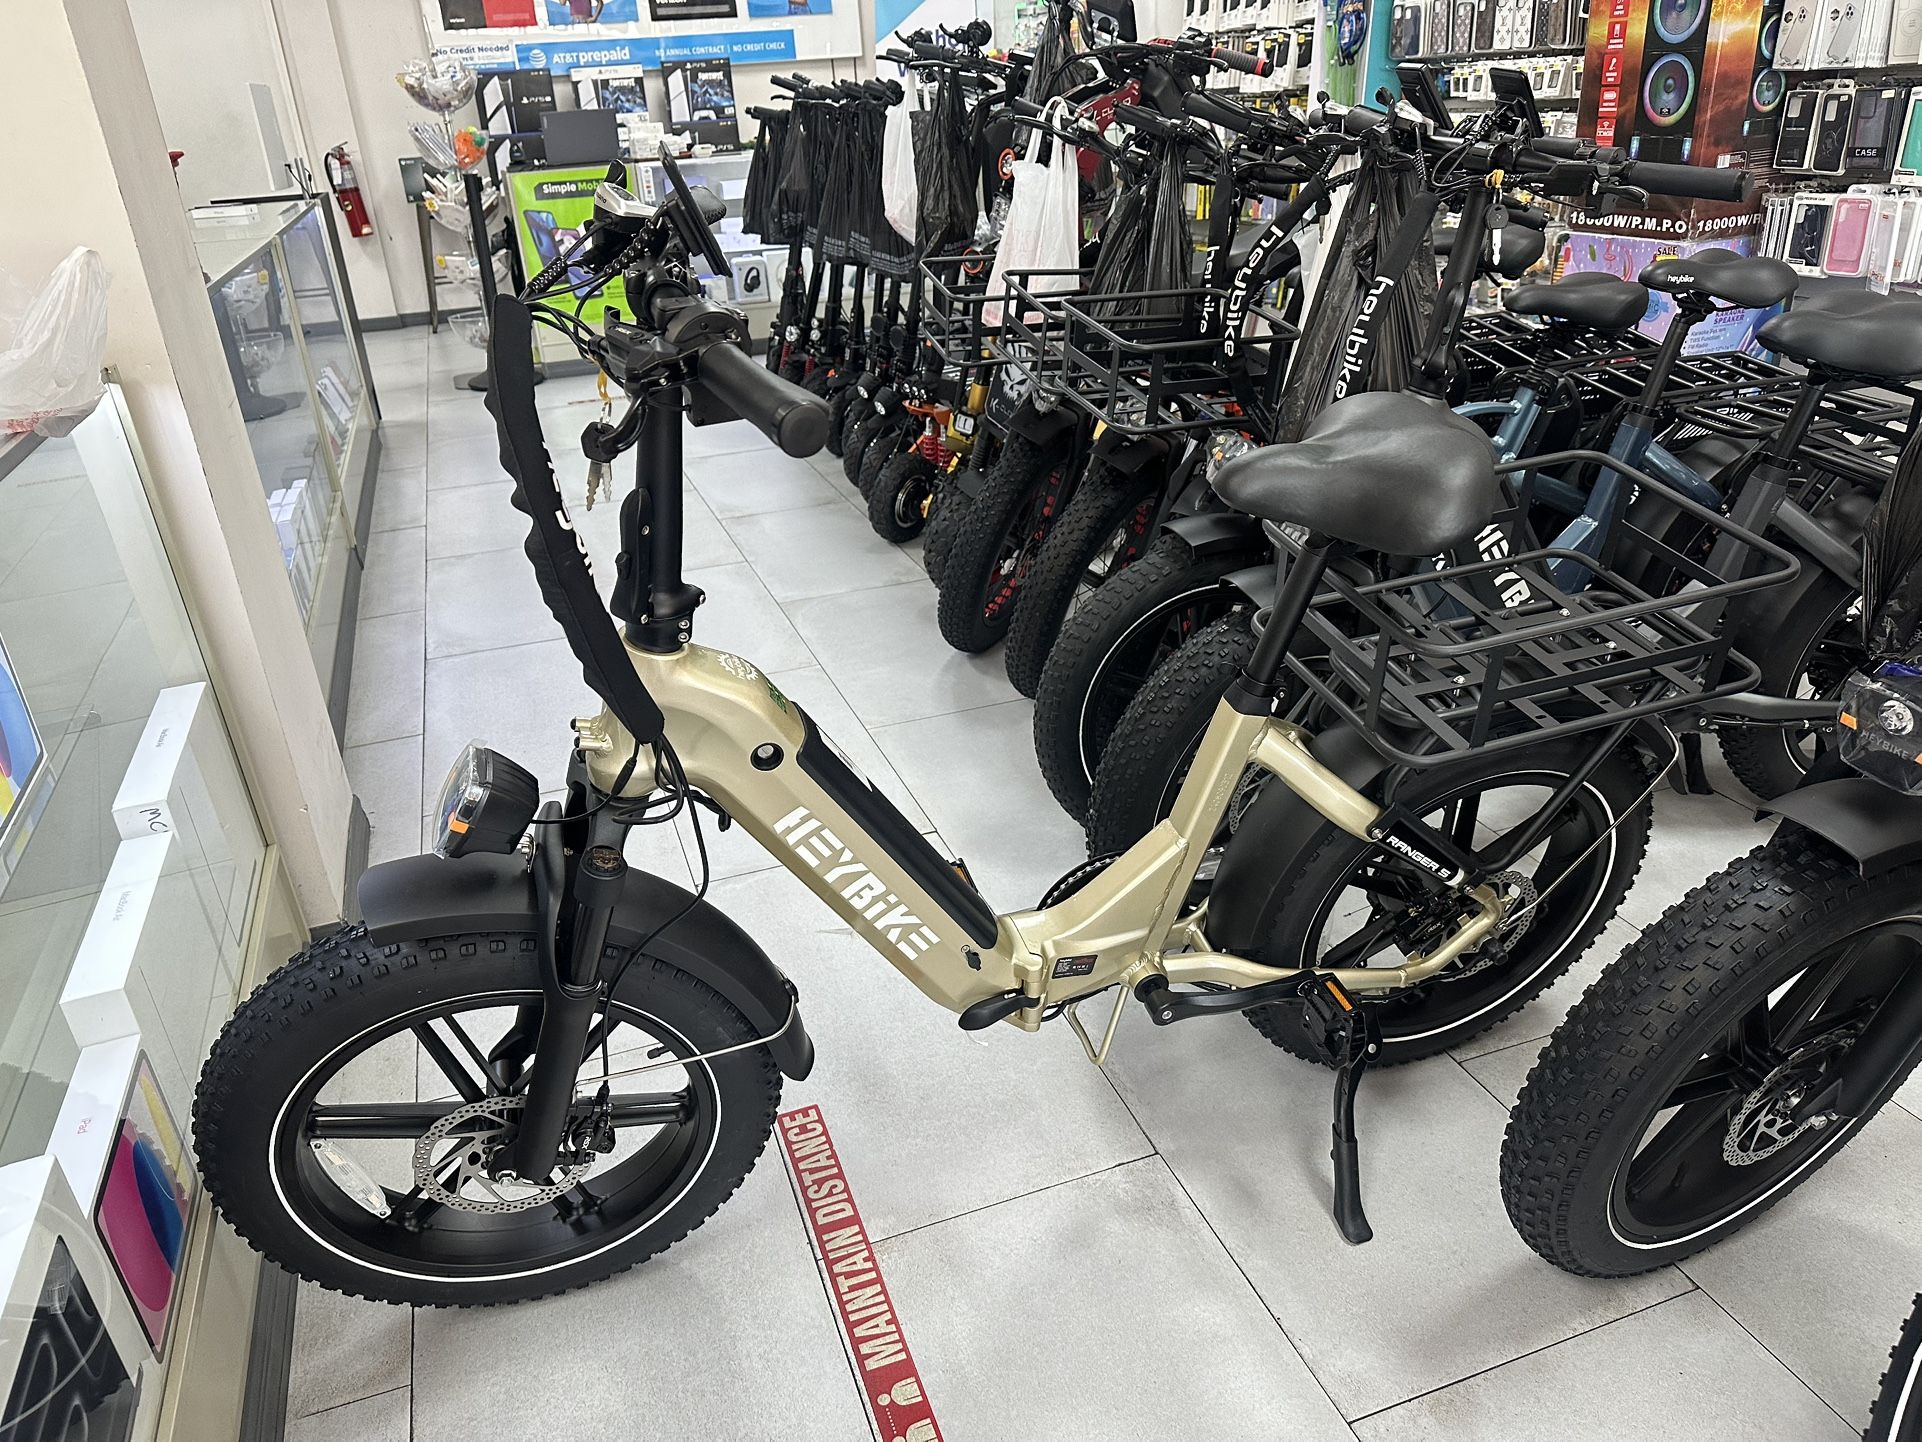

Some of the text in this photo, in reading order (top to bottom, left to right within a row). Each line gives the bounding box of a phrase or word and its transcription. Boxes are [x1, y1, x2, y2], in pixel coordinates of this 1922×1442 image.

[450, 46, 475, 54] Credit
[478, 44, 510, 53] Needed
[692, 45, 724, 54] CONTRACT
[732, 41, 786, 53] NO CREDIT CHECK
[552, 45, 631, 66] AT&T prepaid
[1855, 148, 1877, 157] CASE
[542, 182, 577, 195] Simple
[1657, 245, 1678, 256] SALE
[1667, 274, 1695, 285] heybike
[1224, 225, 1285, 357] heybike
[1713, 314, 1745, 325] SPEAKER
[1335, 275, 1395, 399] heybike
[1860, 728, 1910, 761] HEYBIKE
[1385, 834, 1452, 878] RANGER S
[782, 1108, 908, 1371] MAINTAIN DISTANCE
